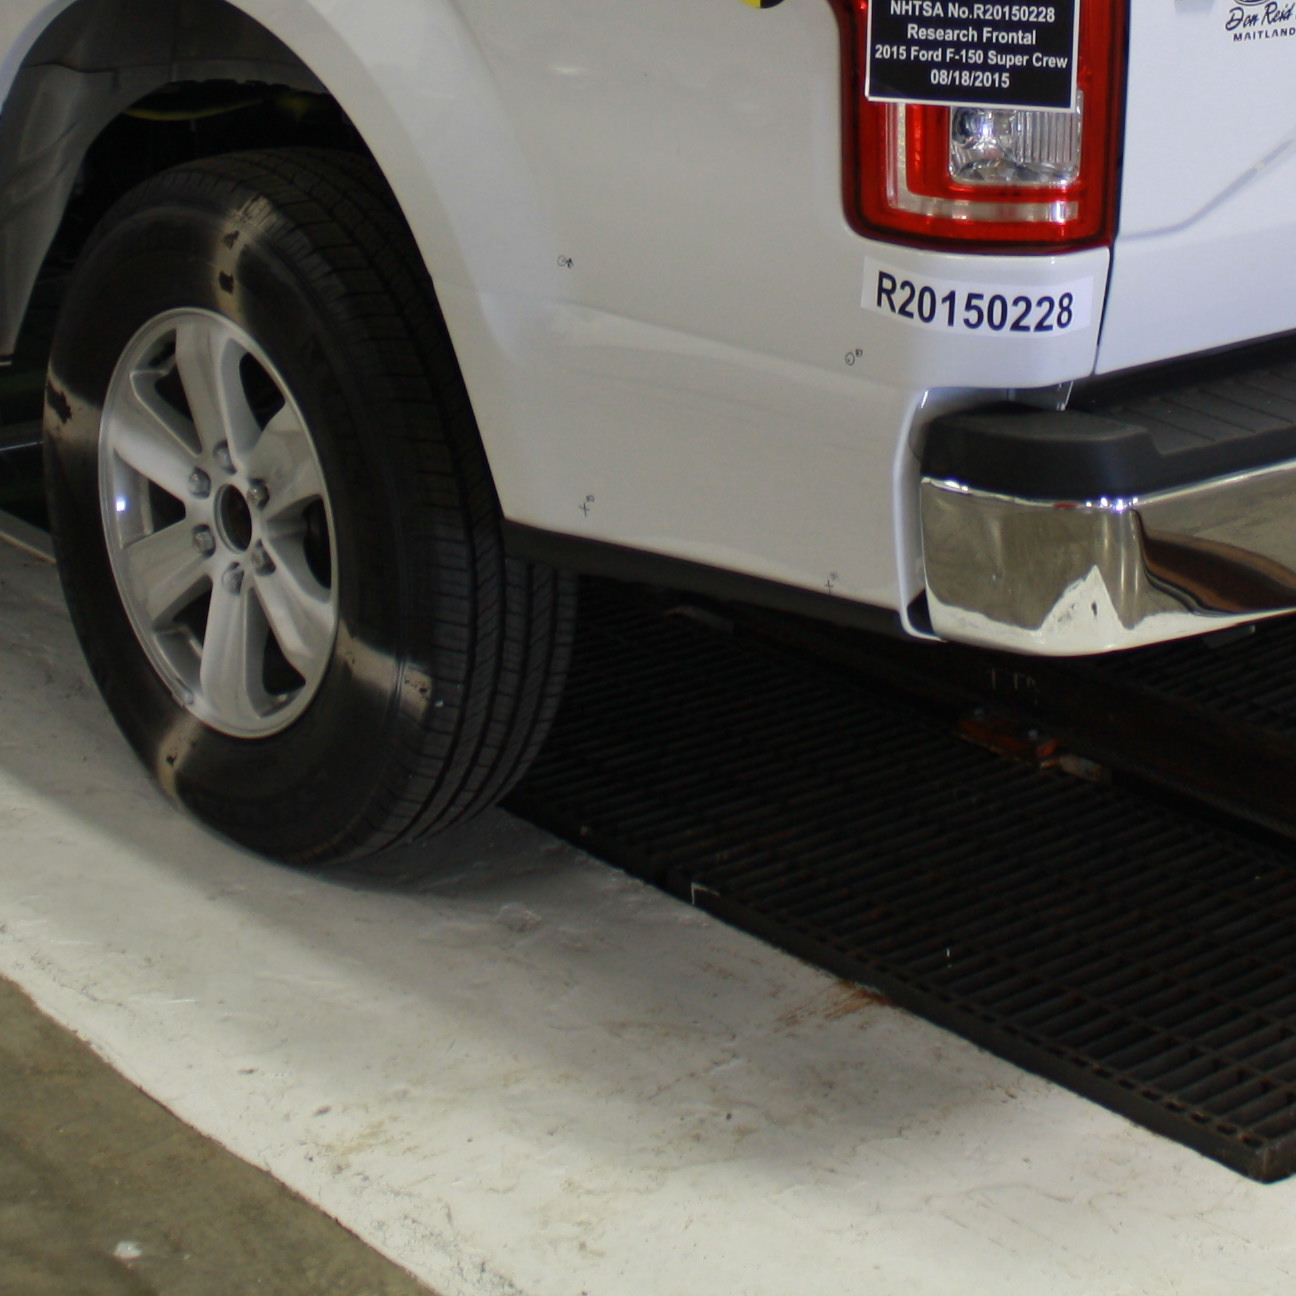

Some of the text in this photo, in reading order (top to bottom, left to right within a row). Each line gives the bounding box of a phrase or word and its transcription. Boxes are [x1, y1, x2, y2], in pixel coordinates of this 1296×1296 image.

[890, 0, 1055, 23] NHTSA No.R20150228
[1261, 1, 1296, 26] Reid
[907, 24, 1036, 45] Research Frontal
[875, 45, 1068, 69] 2015 Ford F-150 Super Crew
[930, 69, 1010, 88] 08/18/2015
[876, 270, 1074, 333] R20150228
